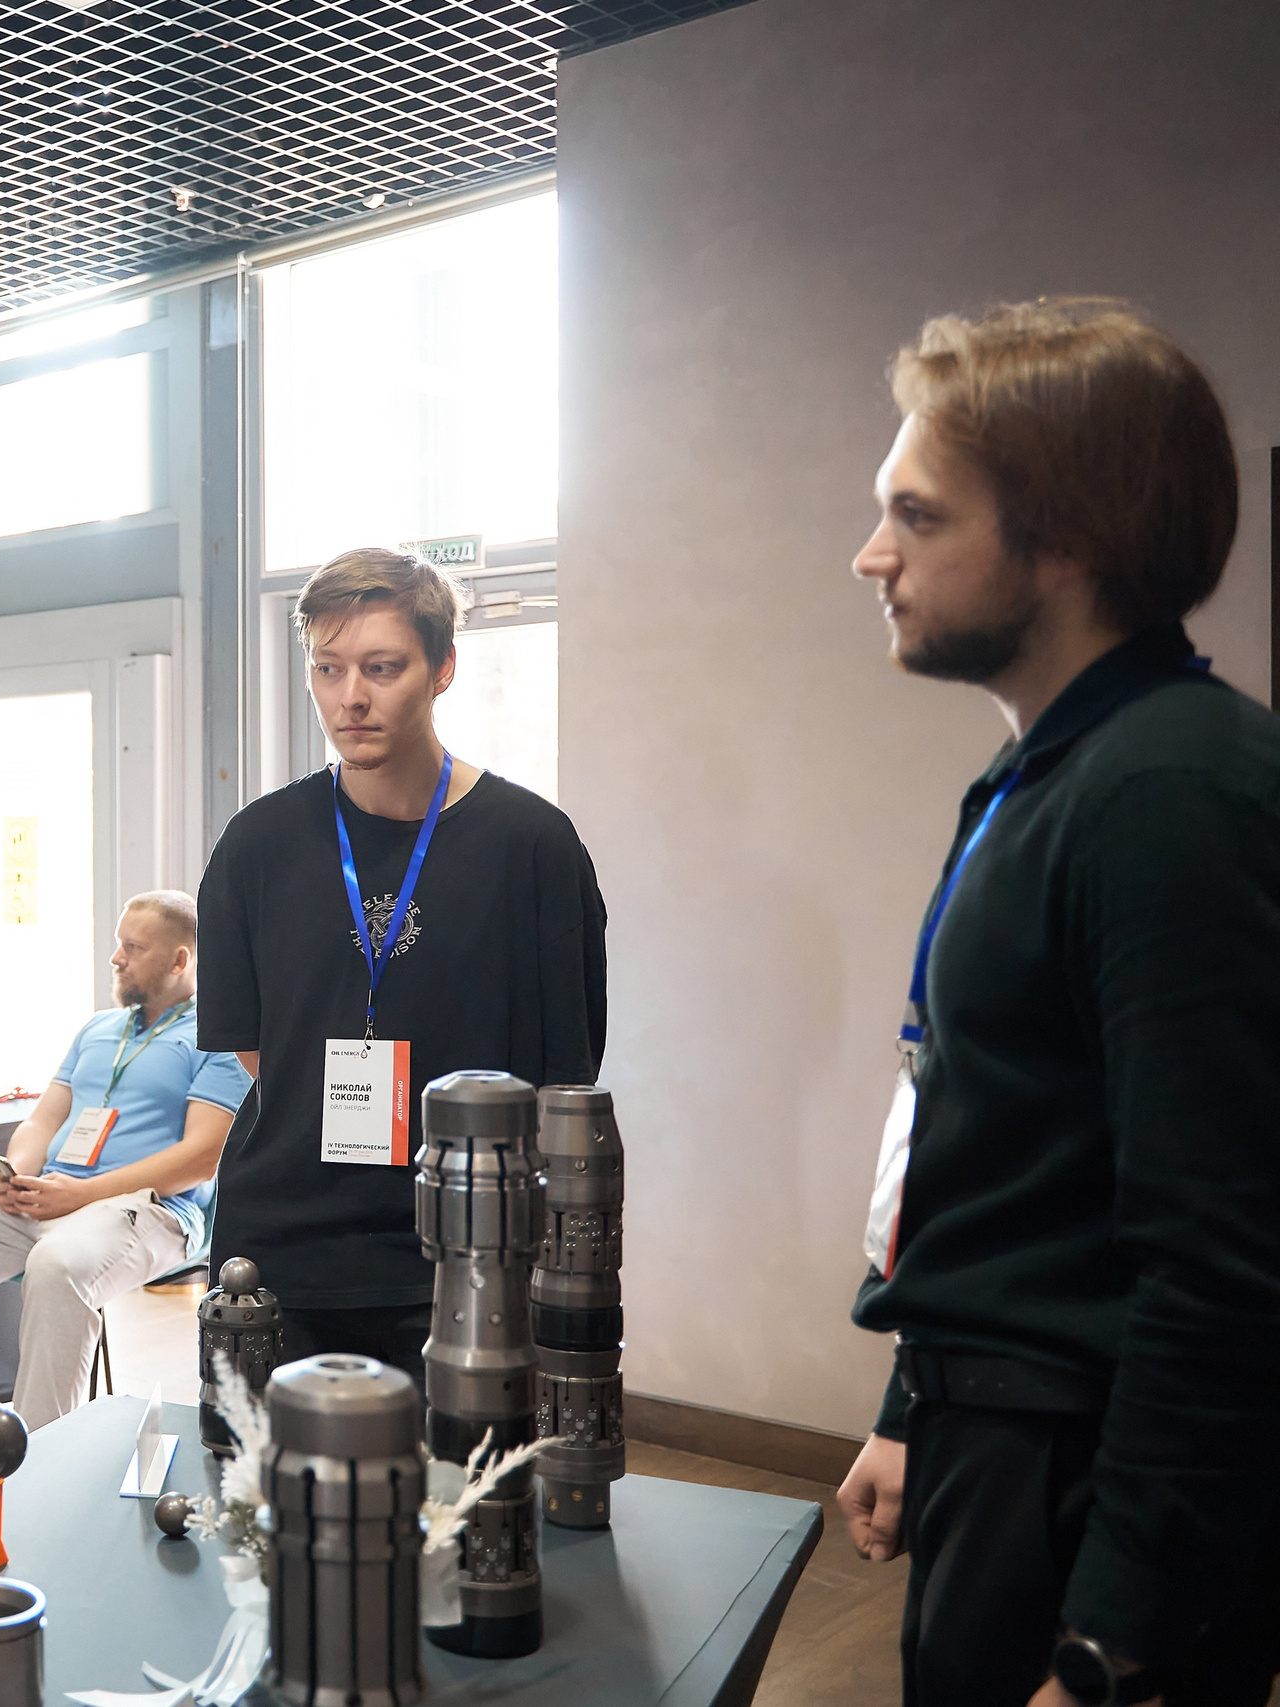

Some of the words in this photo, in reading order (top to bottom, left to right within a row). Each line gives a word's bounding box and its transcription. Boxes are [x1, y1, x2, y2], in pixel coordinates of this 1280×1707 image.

[362, 893, 421, 917] ELESE
[330, 1083, 372, 1093] НИКОЛАЙ
[330, 1093, 370, 1102] СОКОЛОВ
[334, 1143, 390, 1151] ТЕХНОЛОГИЧЕСКИЙ
